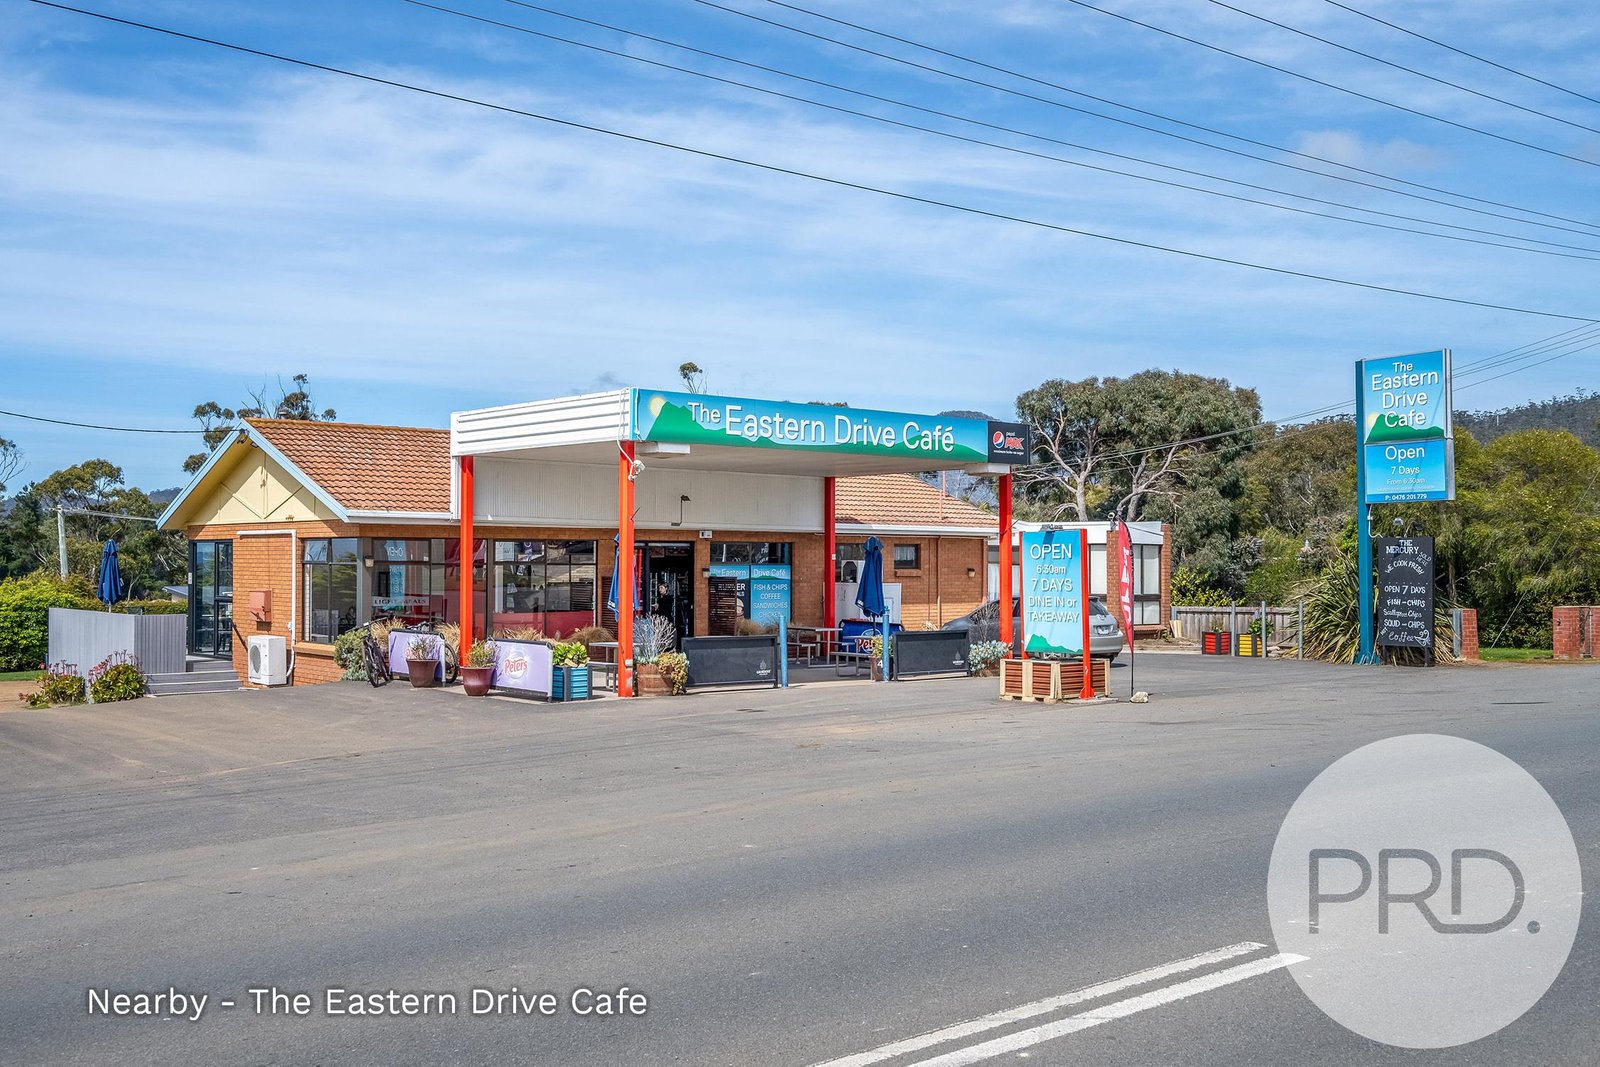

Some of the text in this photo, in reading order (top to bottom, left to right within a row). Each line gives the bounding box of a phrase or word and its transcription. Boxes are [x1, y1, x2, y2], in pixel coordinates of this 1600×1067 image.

[1393, 362, 1413, 372] The
[1371, 371, 1439, 391] Eastern
[1382, 390, 1428, 409] Drive
[1384, 411, 1426, 428] Cafe
[687, 402, 954, 453] The Eastern Drive Café
[1385, 446, 1425, 463] Open
[1391, 465, 1421, 475] 7 Days
[1030, 543, 1072, 559] OPEN
[1385, 545, 1419, 554] MERCURY
[1419, 552, 1432, 562] SOLD
[721, 568, 747, 577] Eastern
[753, 568, 770, 577] Drive
[770, 568, 786, 577] Café
[1036, 564, 1067, 575] 6:30am
[1385, 560, 1425, 575] WE COOK FRESH
[1031, 577, 1074, 593] 7 DAYS
[1384, 585, 1426, 594] OPEN 7 DAYS
[1028, 595, 1078, 608] DINE IN or
[1406, 600, 1426, 608] CHIPS
[1027, 611, 1080, 623] TAKEAWAY
[1407, 620, 1425, 629] CHIPS
[1388, 631, 1414, 642] Coffee
[504, 658, 528, 673] Peters
